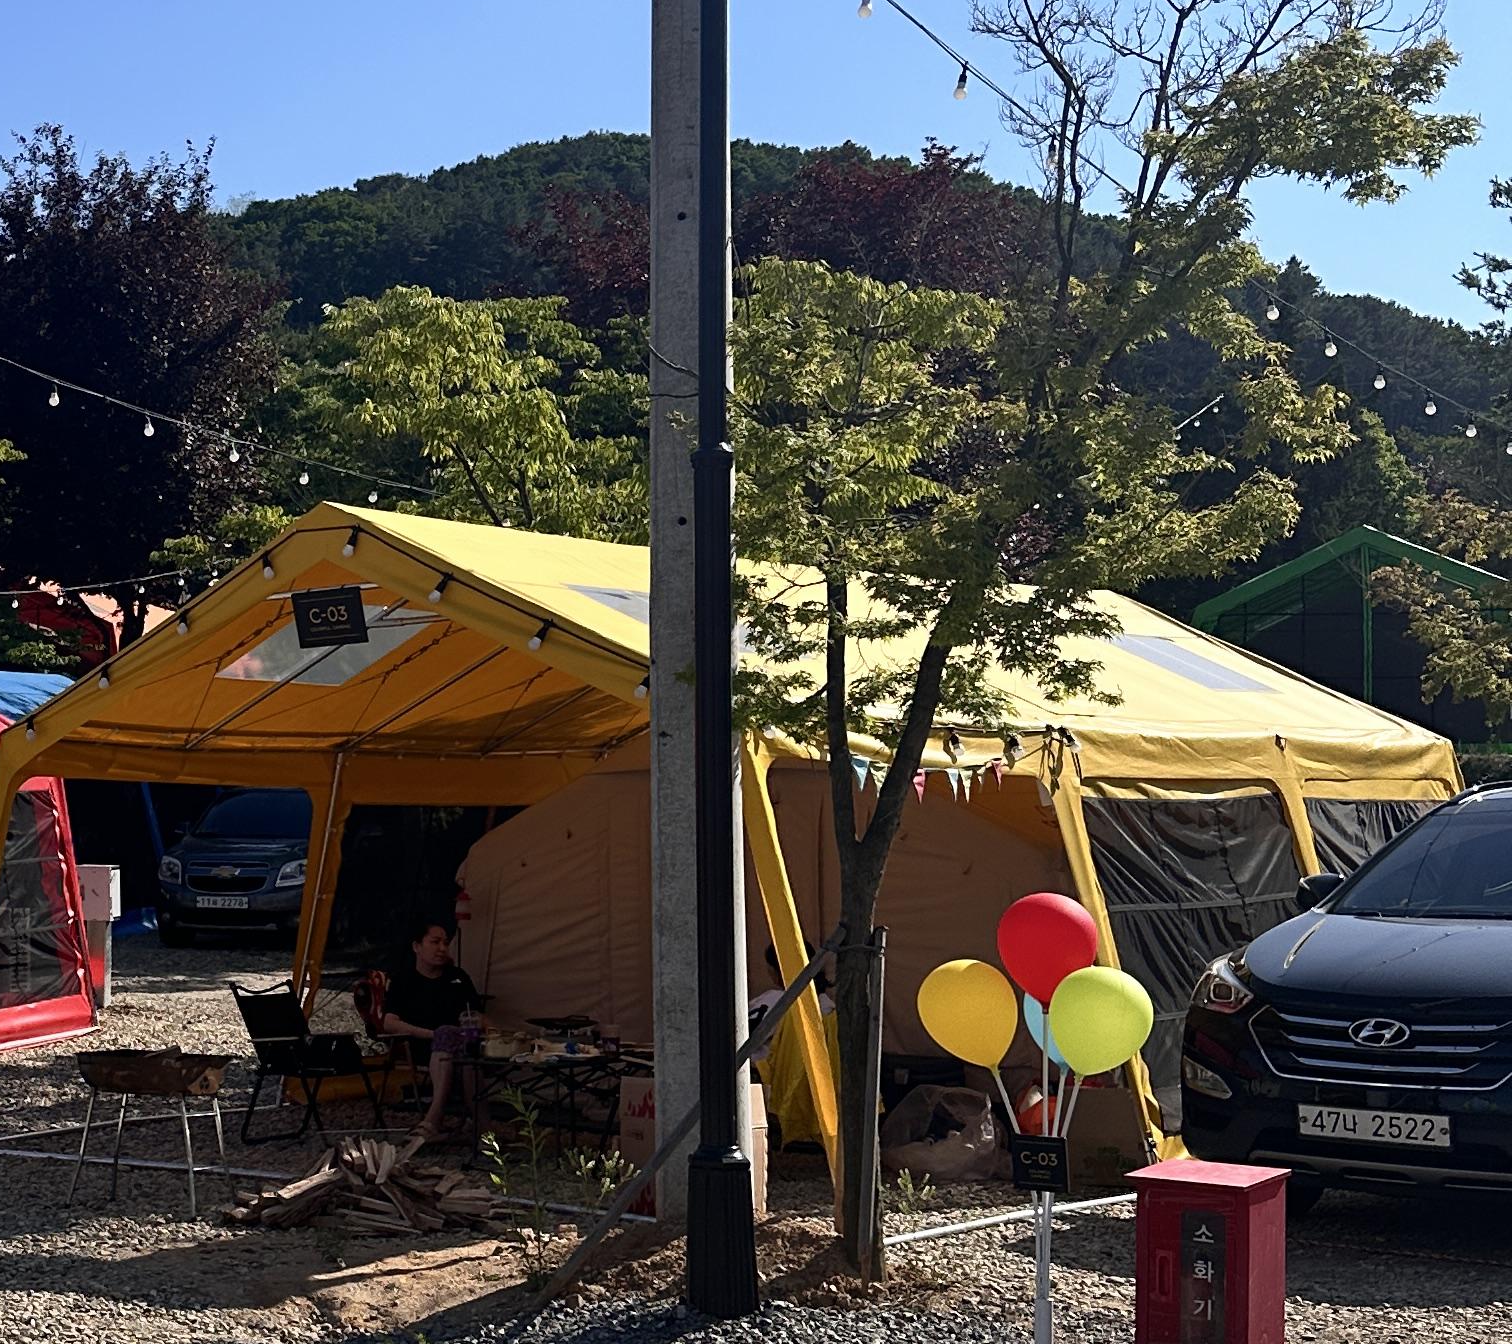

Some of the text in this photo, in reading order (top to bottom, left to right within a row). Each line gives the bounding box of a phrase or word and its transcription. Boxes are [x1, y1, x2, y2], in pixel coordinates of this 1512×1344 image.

[309, 605, 349, 624] C-03
[1311, 1109, 1436, 1142] 47나 2522
[1020, 1151, 1058, 1166] C-03
[1192, 1223, 1215, 1321] 소화기
